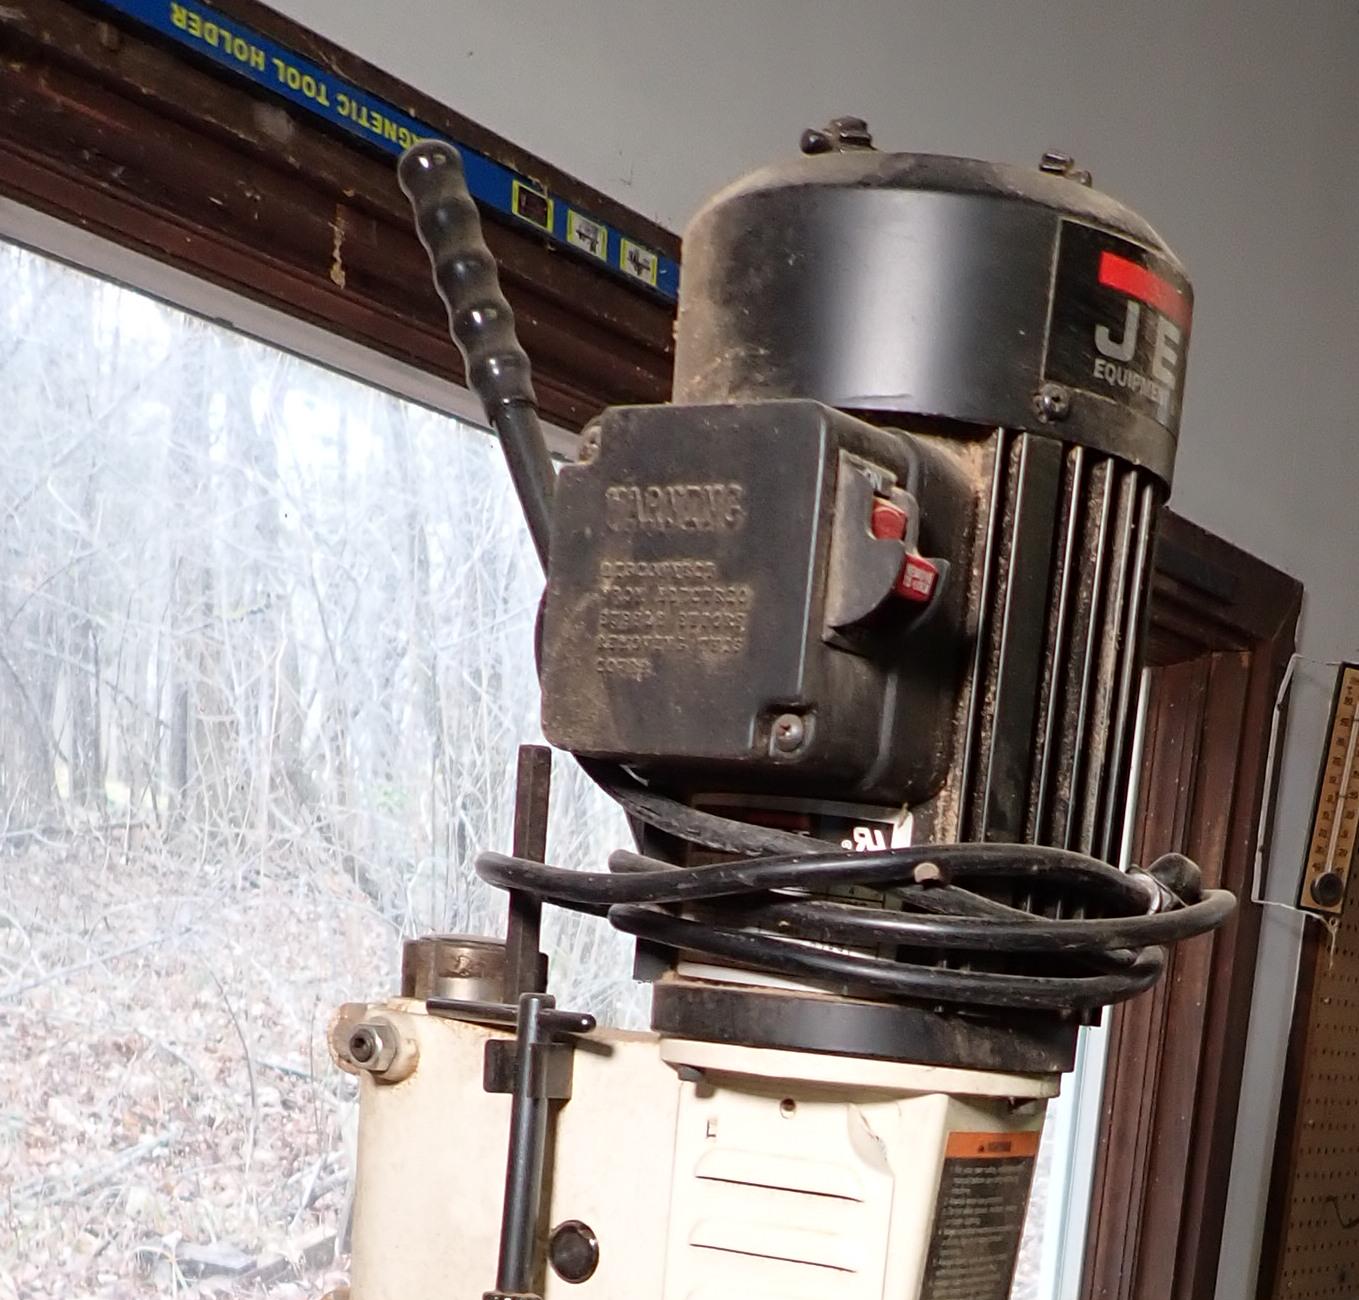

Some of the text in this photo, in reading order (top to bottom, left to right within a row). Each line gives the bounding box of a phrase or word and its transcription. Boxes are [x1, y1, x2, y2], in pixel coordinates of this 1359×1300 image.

[171, 2, 424, 150] GNETIC TOOL HOLDER
